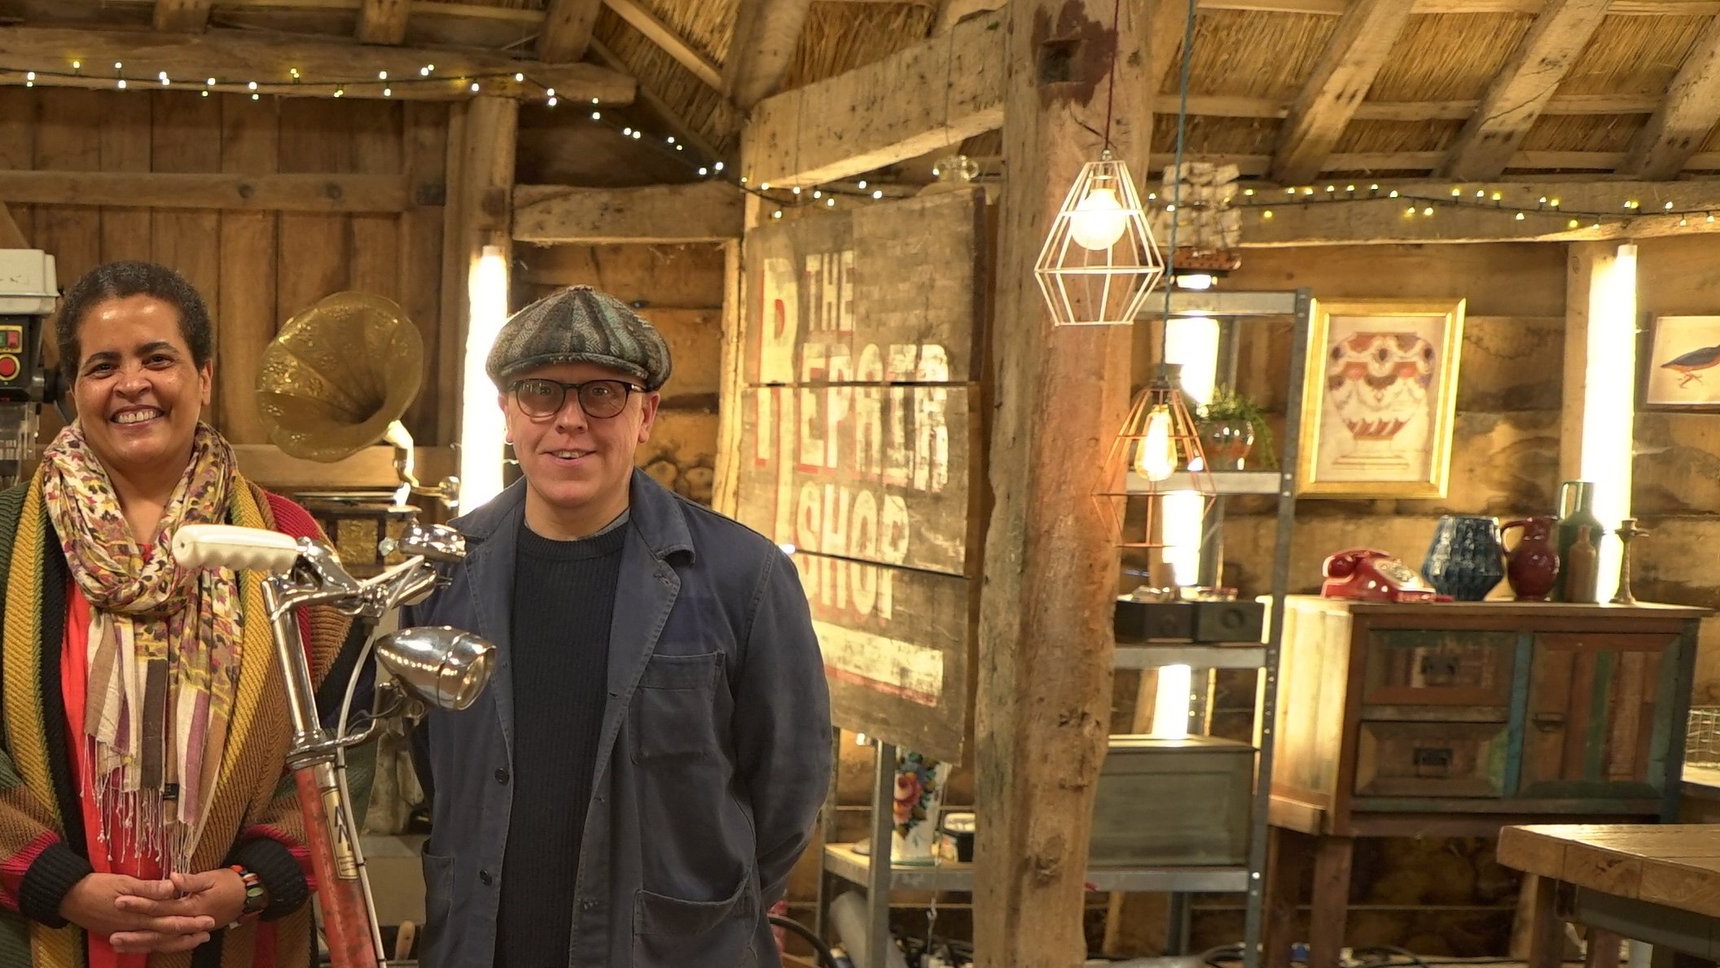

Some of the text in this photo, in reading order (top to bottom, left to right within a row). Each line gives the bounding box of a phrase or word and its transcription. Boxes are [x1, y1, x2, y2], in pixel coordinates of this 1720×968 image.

[805, 251, 856, 334] THE
[755, 257, 949, 545] REPAIR
[796, 481, 910, 621] SHOP
